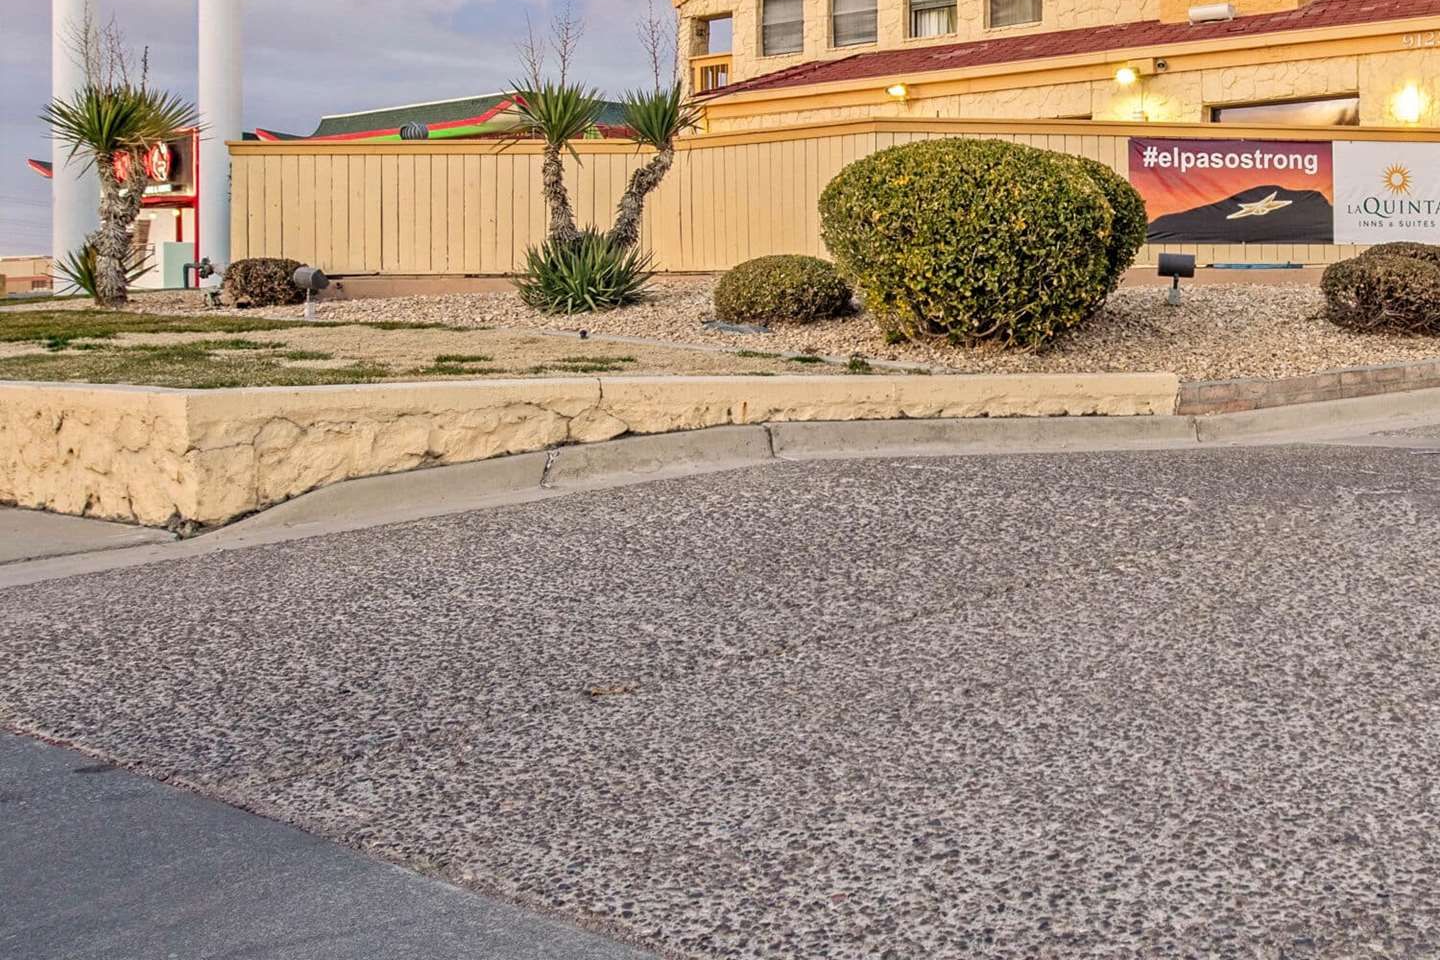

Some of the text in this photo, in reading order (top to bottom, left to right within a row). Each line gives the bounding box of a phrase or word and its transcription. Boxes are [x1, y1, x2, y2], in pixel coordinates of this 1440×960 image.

[1143, 146, 1318, 175] #elpasostrong
[1347, 204, 1362, 215] LA
[1358, 220, 1384, 228] INNS
[1399, 220, 1436, 228] SUITES
